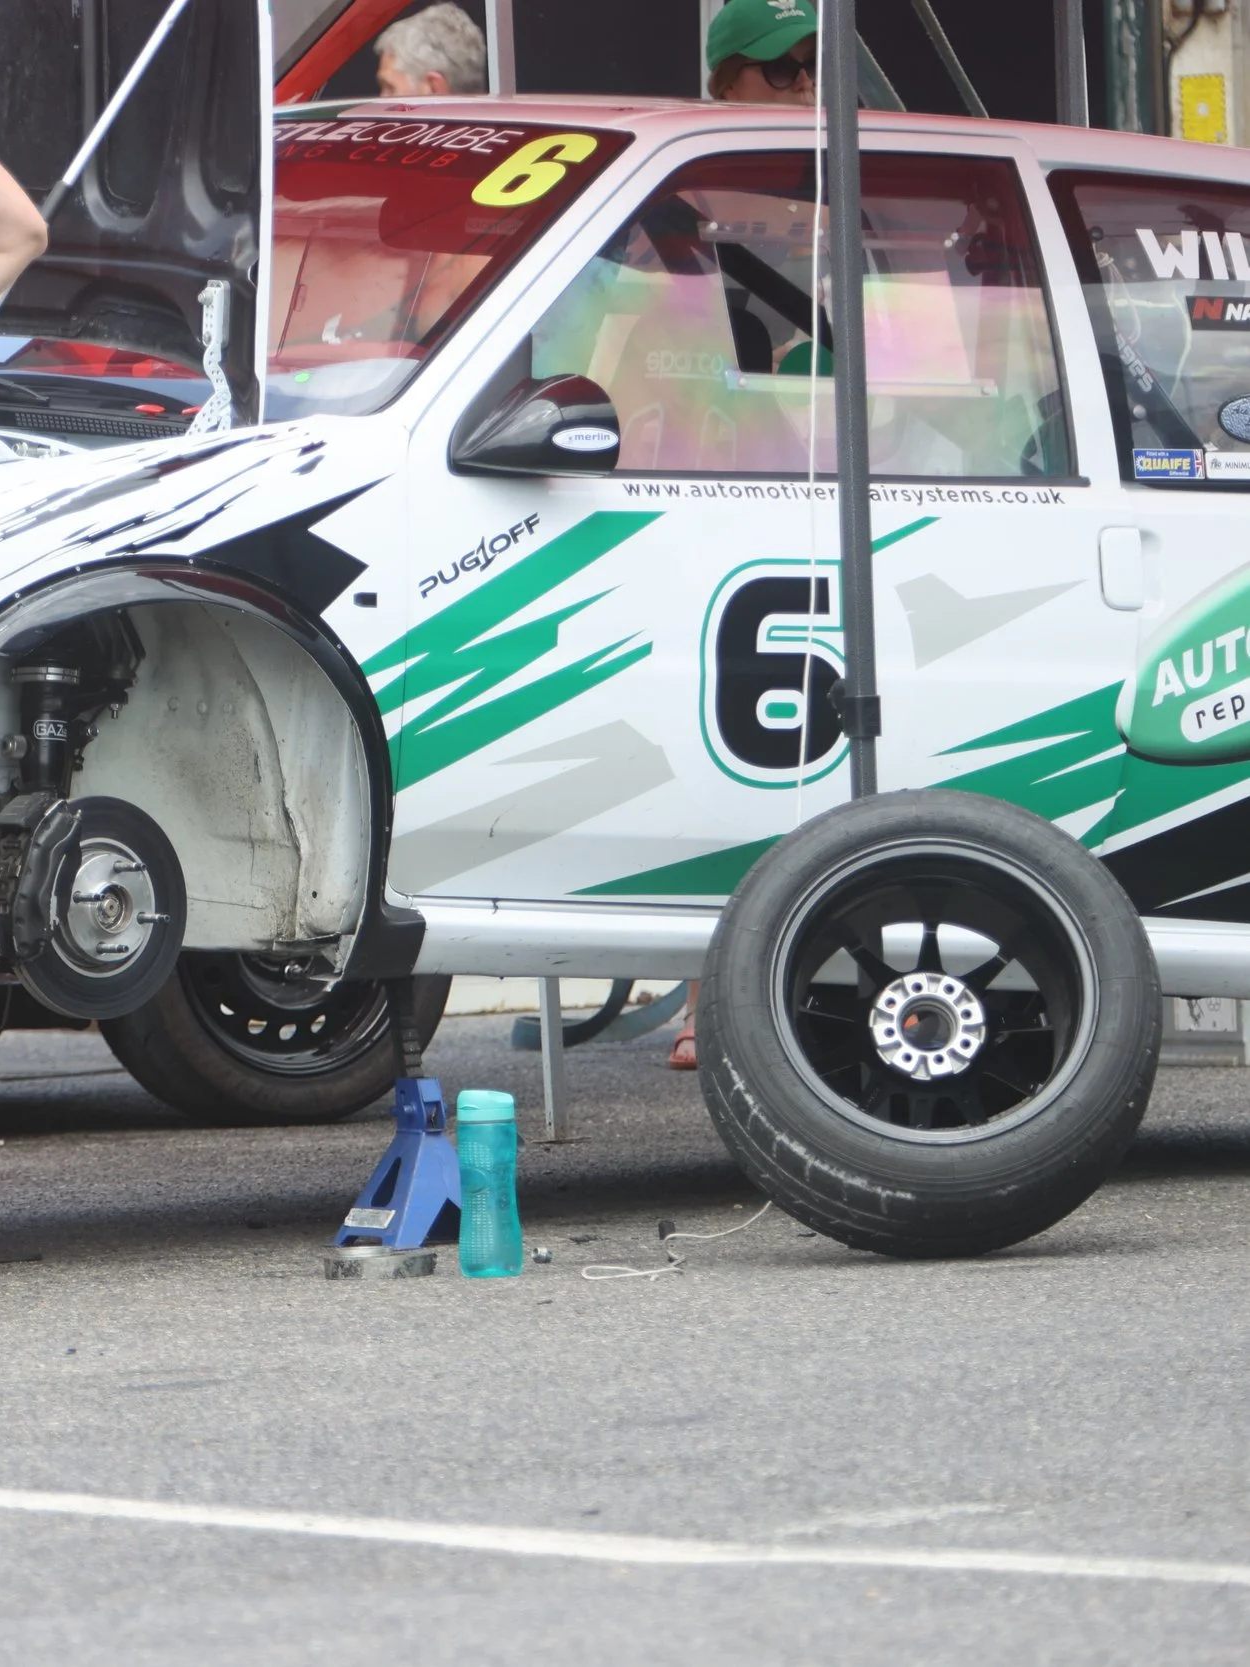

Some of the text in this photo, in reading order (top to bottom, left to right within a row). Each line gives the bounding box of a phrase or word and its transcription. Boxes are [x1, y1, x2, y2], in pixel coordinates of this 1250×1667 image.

[350, 144, 459, 168] CLUB
[471, 133, 597, 207] 6
[574, 432, 611, 441] merlin
[1137, 456, 1191, 471] QUAIFE
[715, 576, 843, 770] 6
[1152, 626, 1250, 708] AUT
